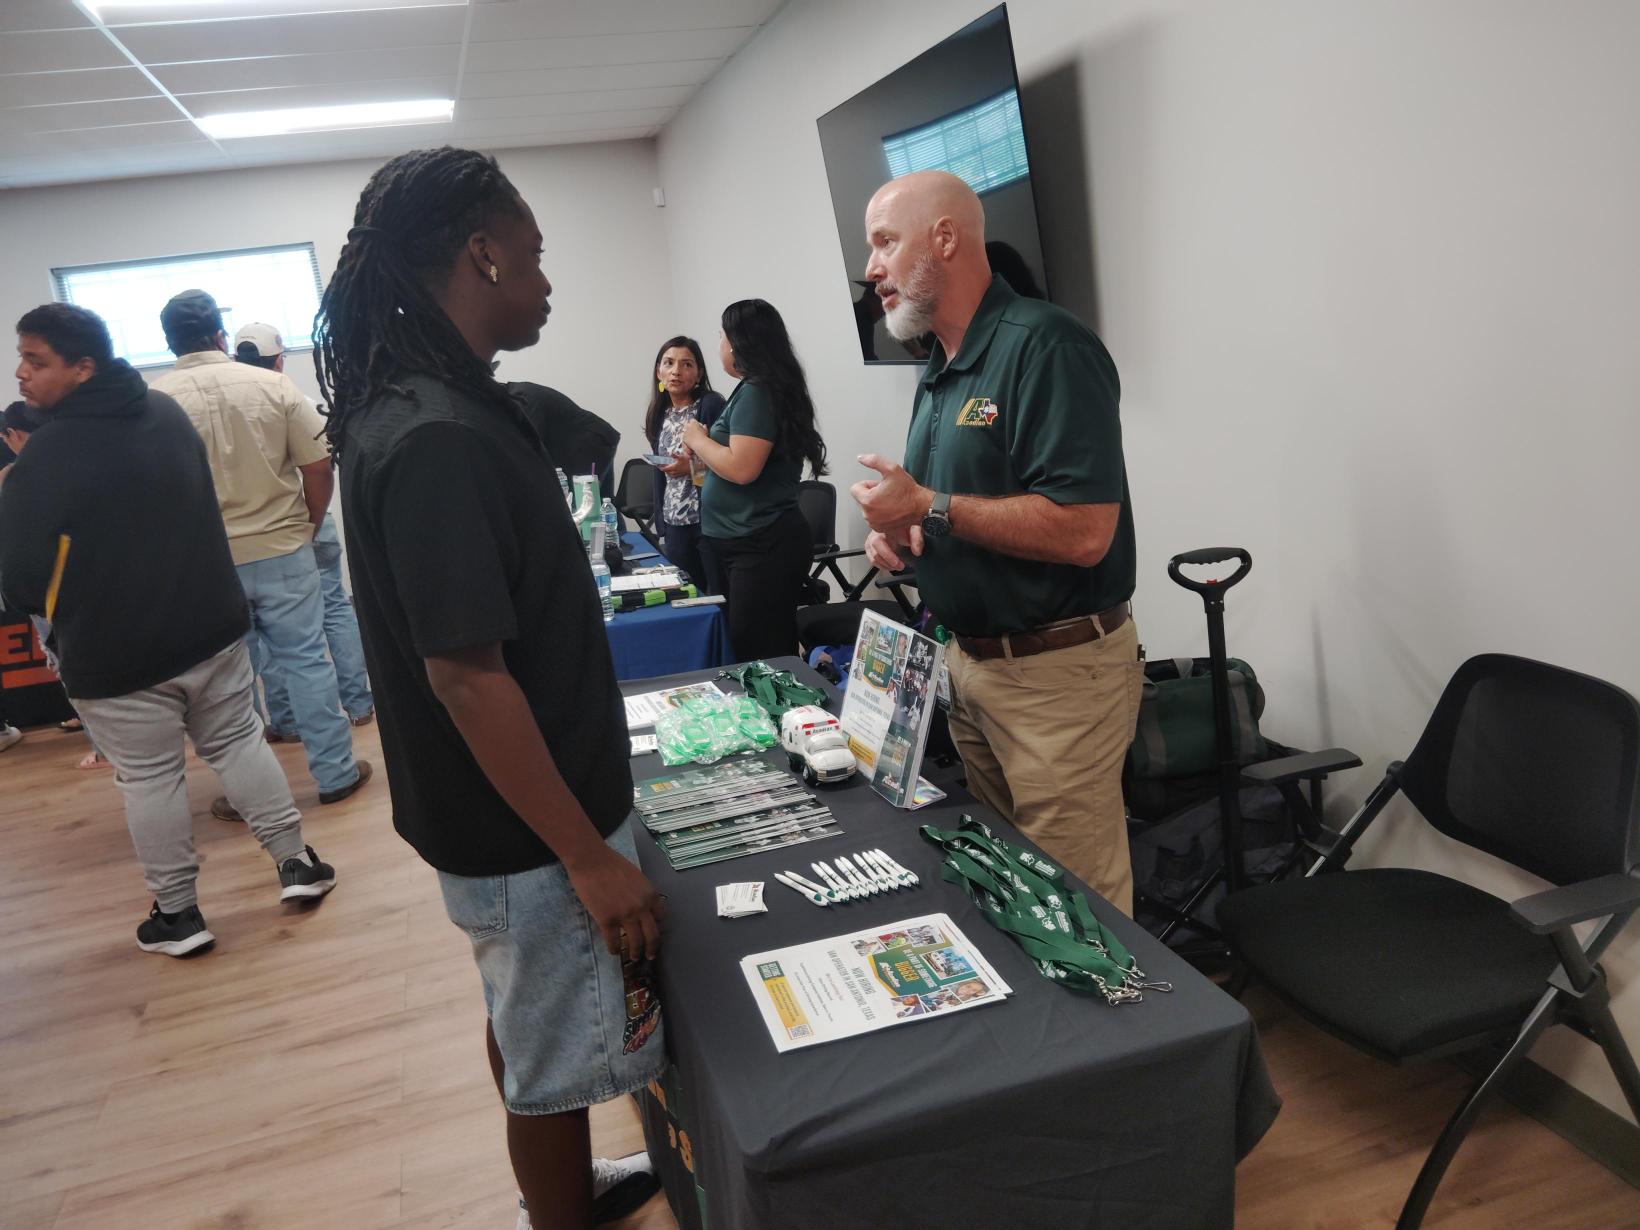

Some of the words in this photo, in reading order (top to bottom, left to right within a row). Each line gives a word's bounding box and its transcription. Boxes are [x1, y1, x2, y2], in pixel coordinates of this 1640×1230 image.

[0, 623, 46, 664] E
[851, 966, 866, 978] NOW
[894, 960, 919, 982] BIGGER
[857, 977, 876, 994] HIRING
[859, 1006, 876, 1021] TEXAS
